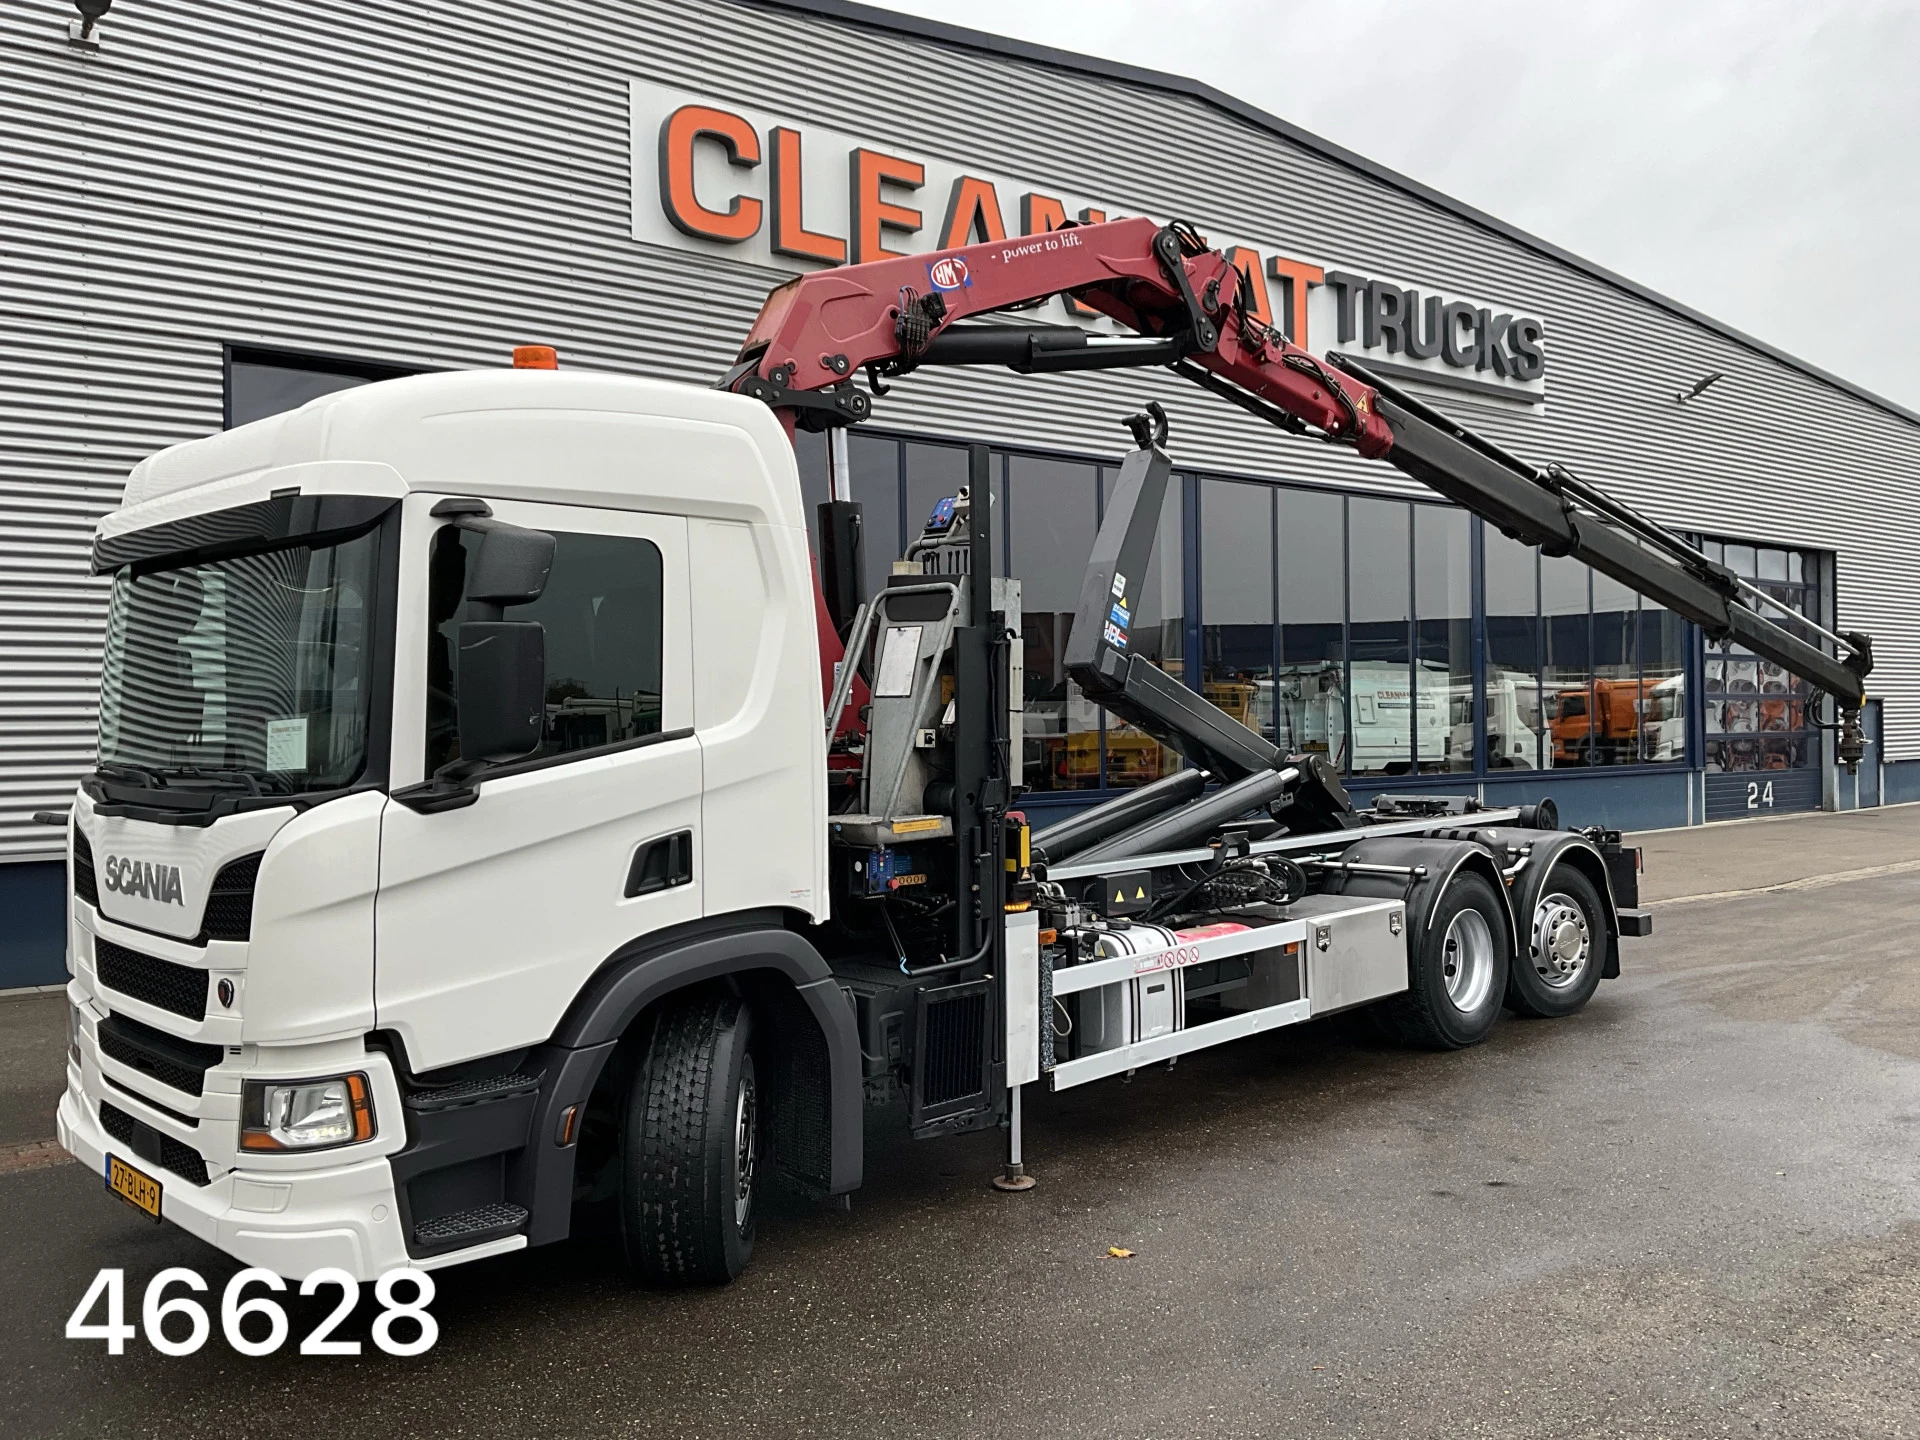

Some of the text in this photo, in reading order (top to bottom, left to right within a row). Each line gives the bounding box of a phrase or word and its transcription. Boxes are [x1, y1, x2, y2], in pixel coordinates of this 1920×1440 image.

[1002, 243, 1042, 263] power
[1045, 239, 1058, 251] to
[1325, 270, 1545, 382] TRUCKS
[1747, 781, 1774, 809] 24
[105, 855, 185, 907] SCANIA
[113, 1164, 156, 1209] 27-BLH-9
